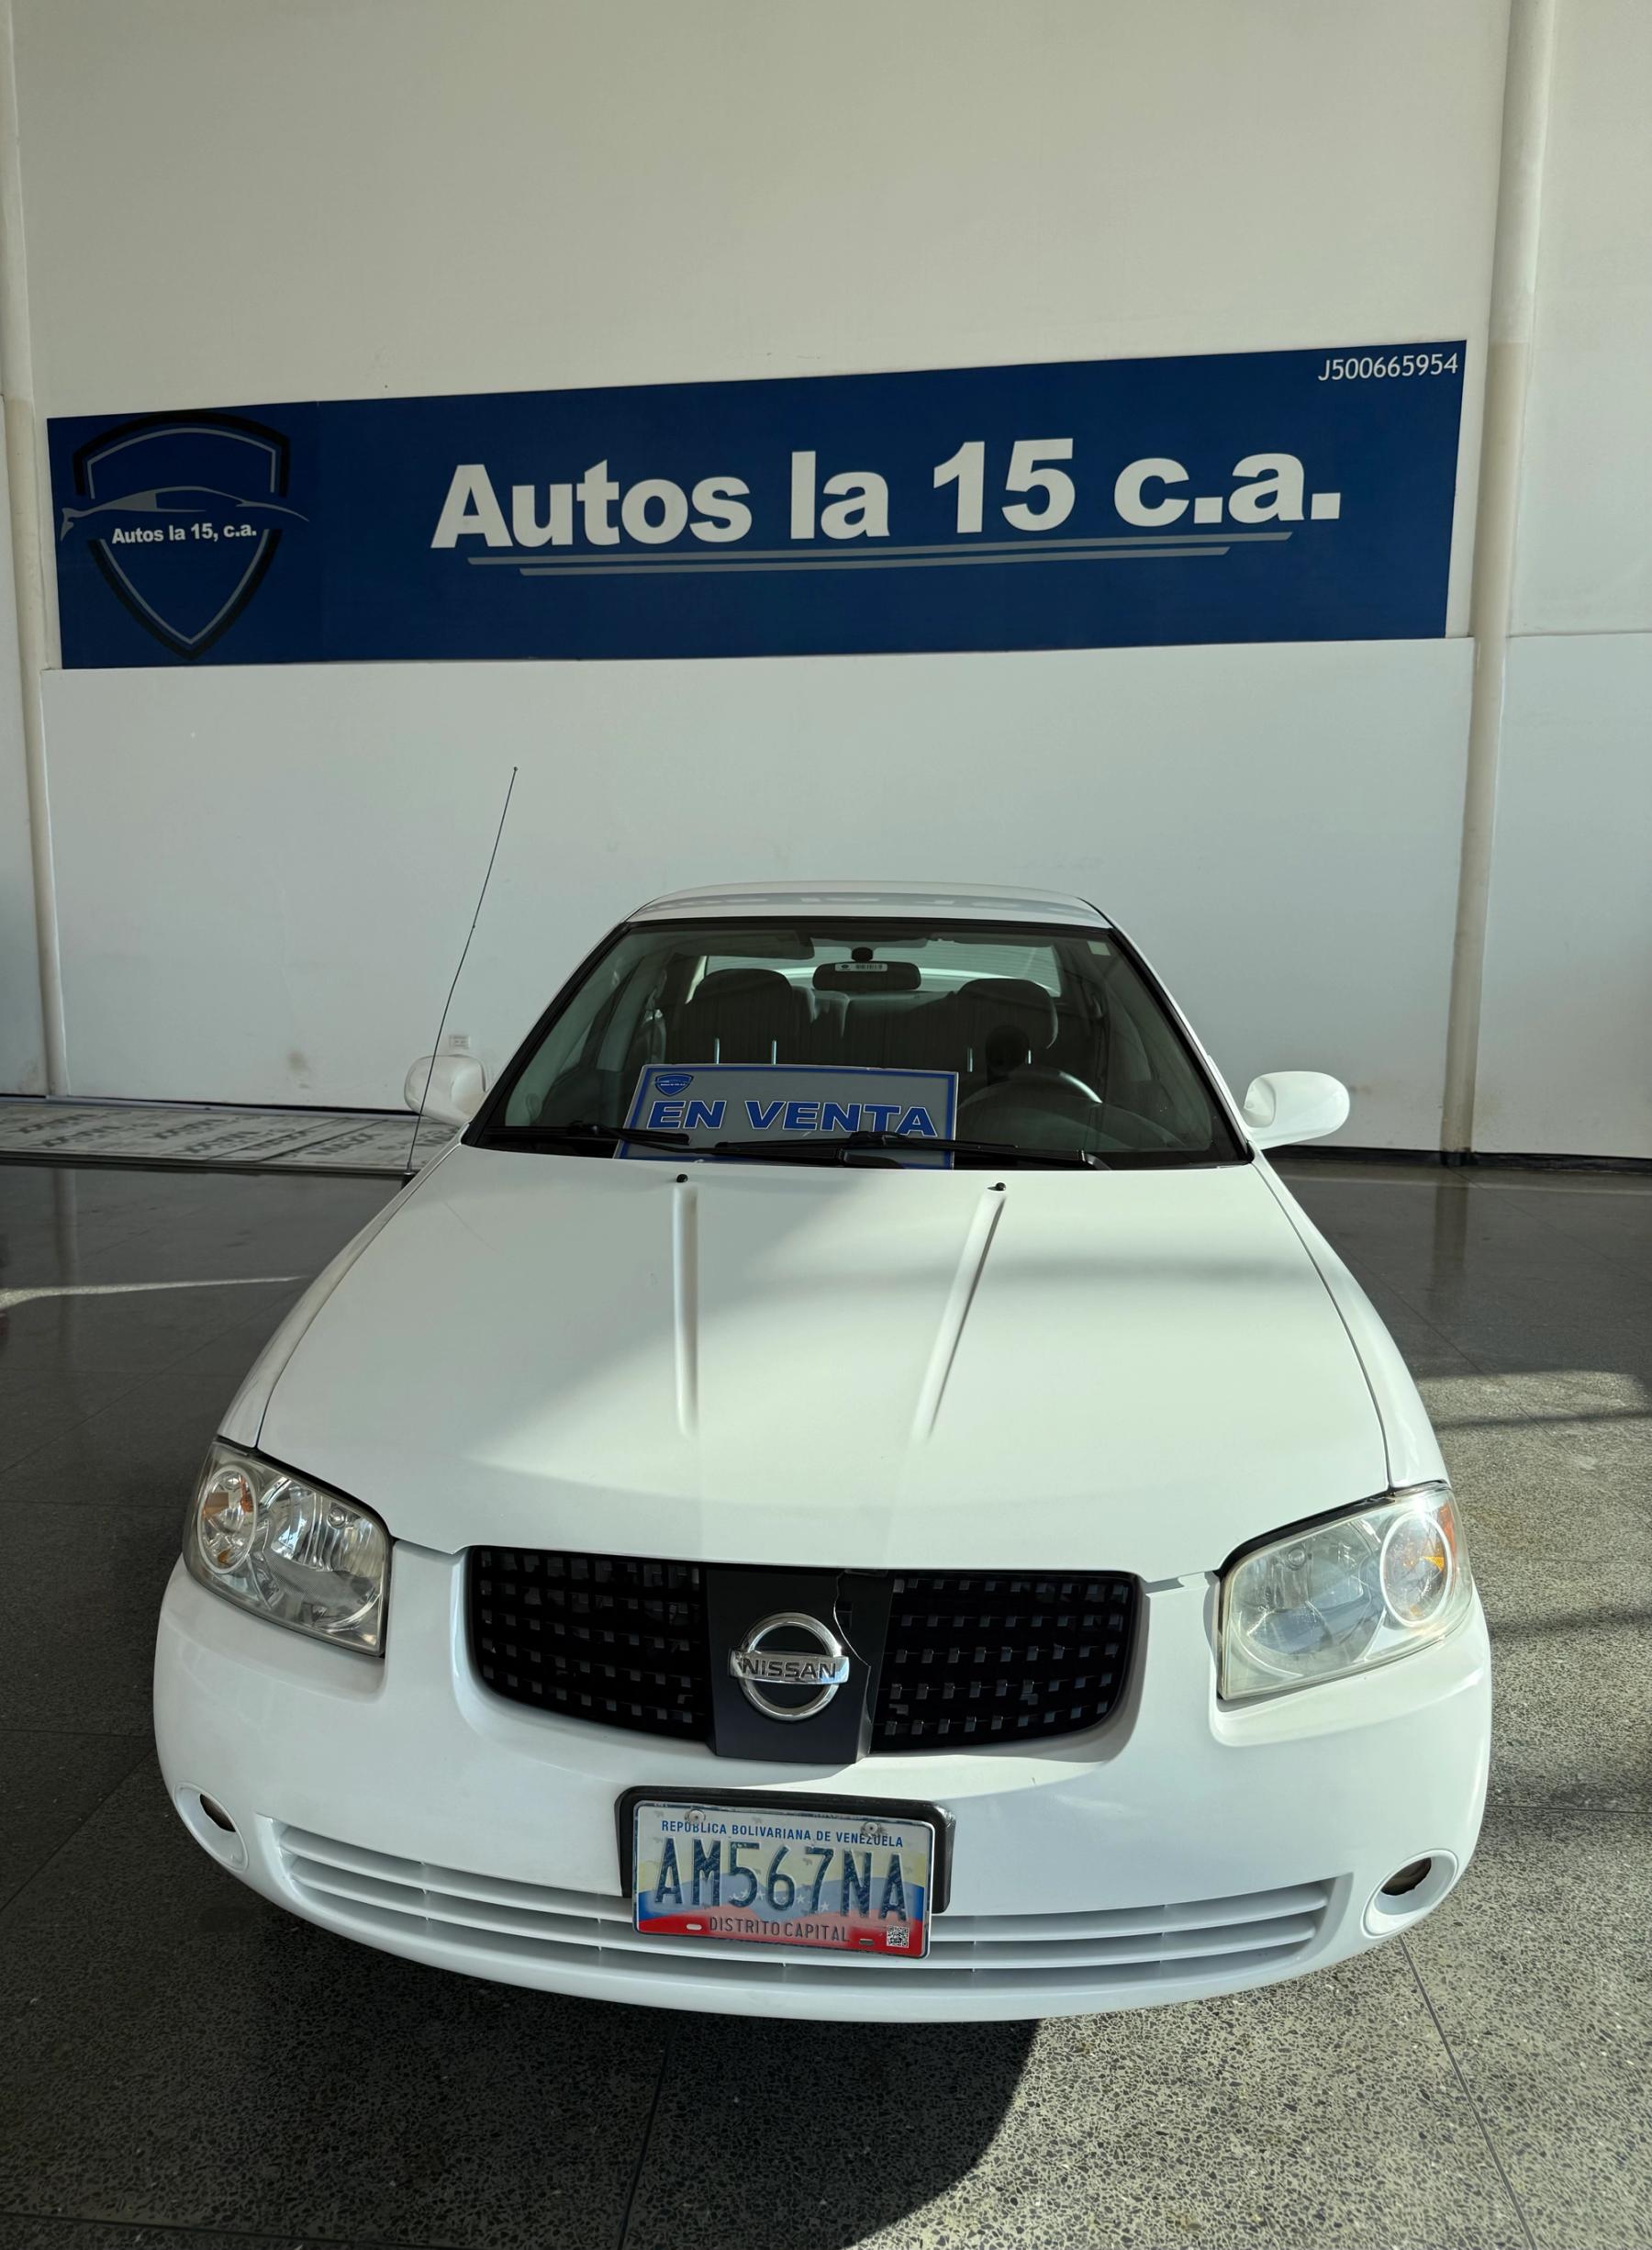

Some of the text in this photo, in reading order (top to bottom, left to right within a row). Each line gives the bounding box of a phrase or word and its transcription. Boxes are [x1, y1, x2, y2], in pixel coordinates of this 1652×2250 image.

[1318, 353, 1458, 381] J500665954
[431, 438, 1341, 548] Autos la 15 c.a.
[111, 522, 257, 544] Autos la 15, c.a.
[647, 1100, 938, 1137] EN VENTA
[742, 1658, 836, 1679] NISSAN
[731, 1824, 811, 1841] BOLIVARIANA
[816, 1830, 831, 1841] DE
[836, 1831, 903, 1848] VENEZUELA
[654, 1836, 908, 1922] AM567NA
[709, 1916, 851, 1942] DISTRITO CAPITAL
